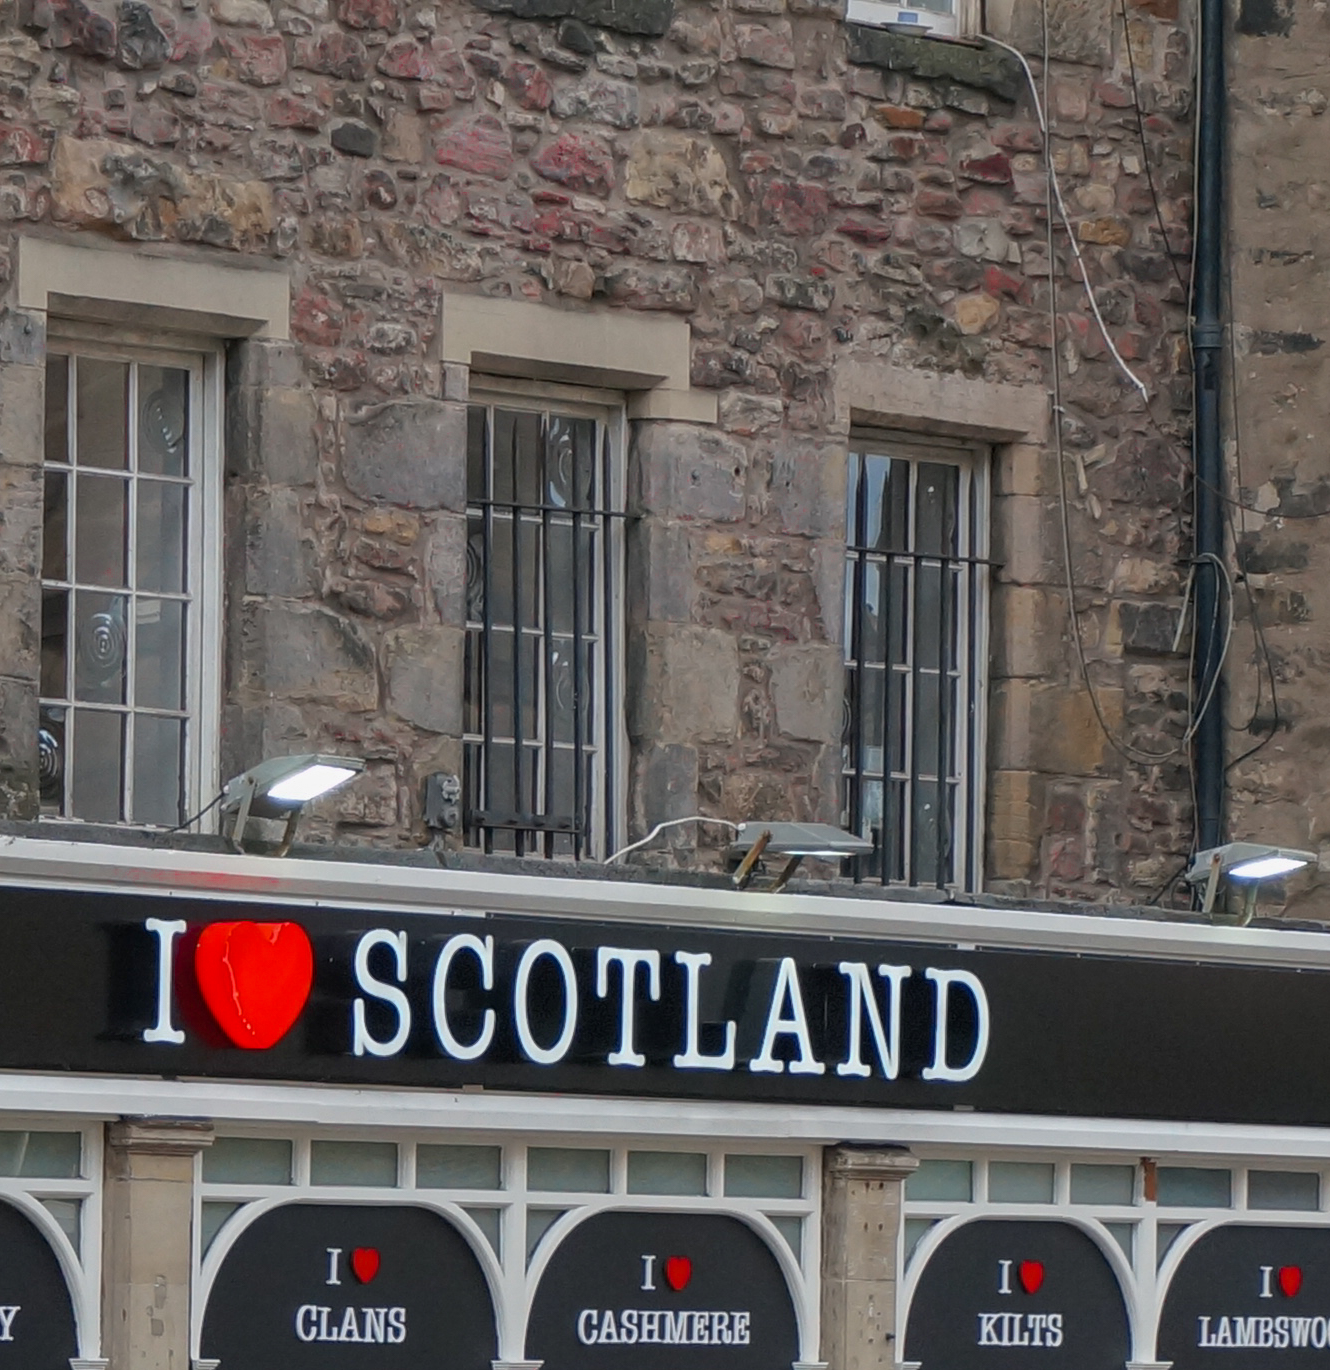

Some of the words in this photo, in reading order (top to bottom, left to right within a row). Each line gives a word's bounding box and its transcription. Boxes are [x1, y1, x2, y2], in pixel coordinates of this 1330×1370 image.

[143, 917, 187, 1043] I
[352, 928, 990, 1082] SCOTLAND
[326, 1248, 342, 1285] I
[641, 1254, 656, 1290] I
[998, 1260, 1012, 1294] I
[1260, 1266, 1273, 1298] I
[296, 1305, 406, 1344] CLANS
[578, 1309, 750, 1345] CASHMERE
[978, 1312, 1062, 1347] KILTS
